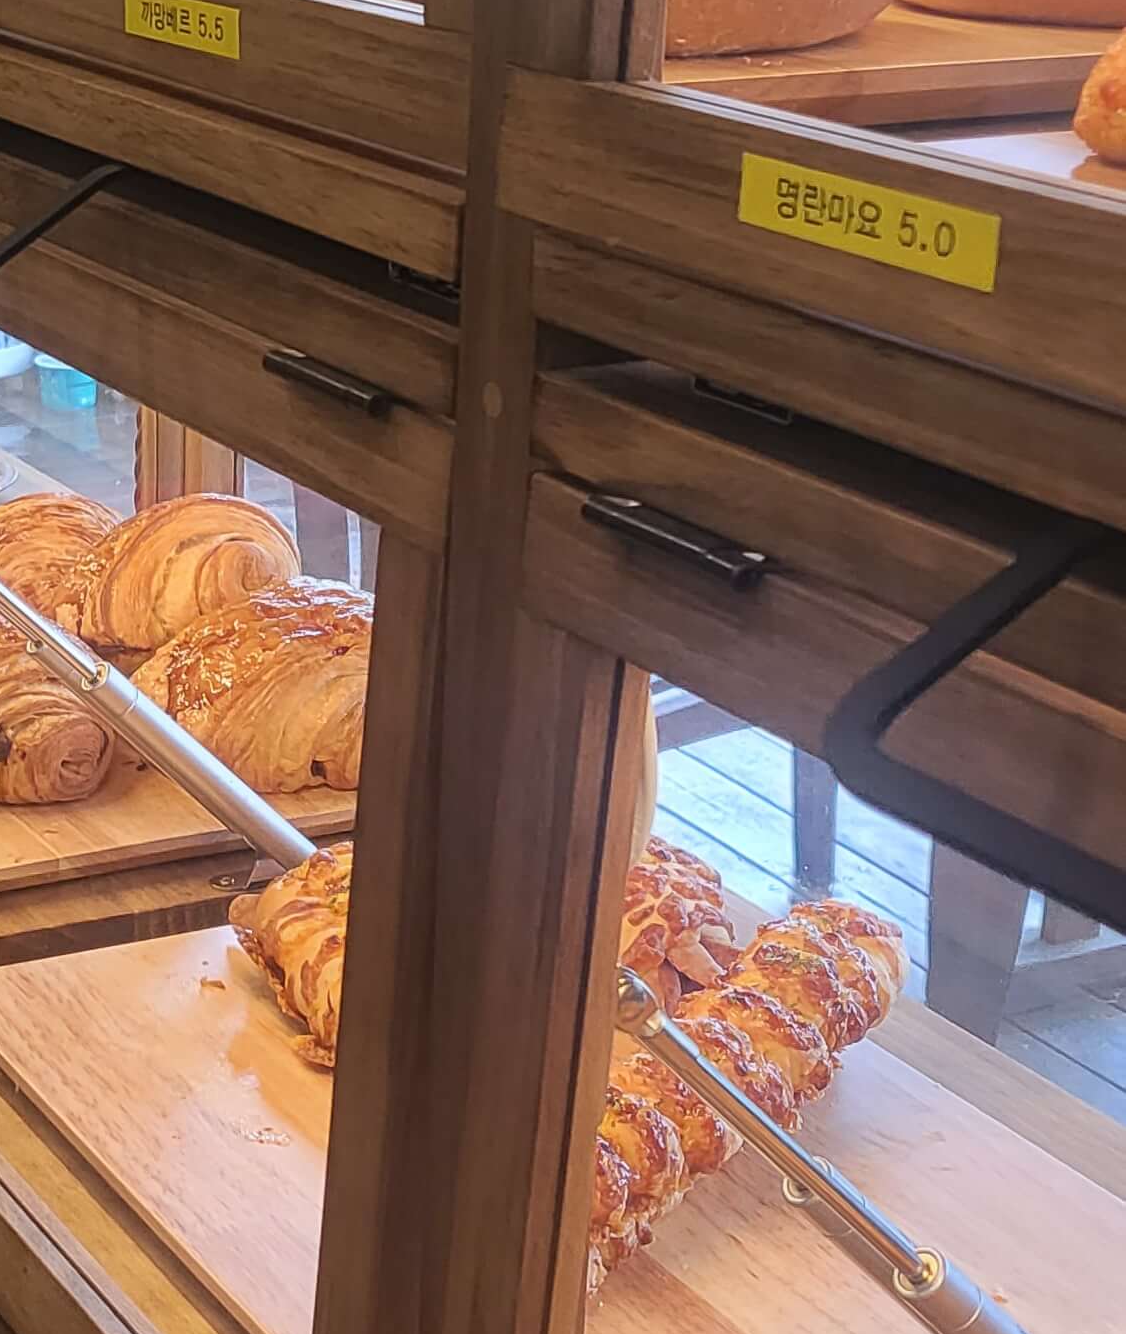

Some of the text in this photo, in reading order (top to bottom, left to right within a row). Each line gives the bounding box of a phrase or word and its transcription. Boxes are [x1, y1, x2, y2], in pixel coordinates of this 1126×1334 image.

[140, 1, 224, 42] 까망베르 5.5
[776, 177, 957, 258] 명란마요 5.0
